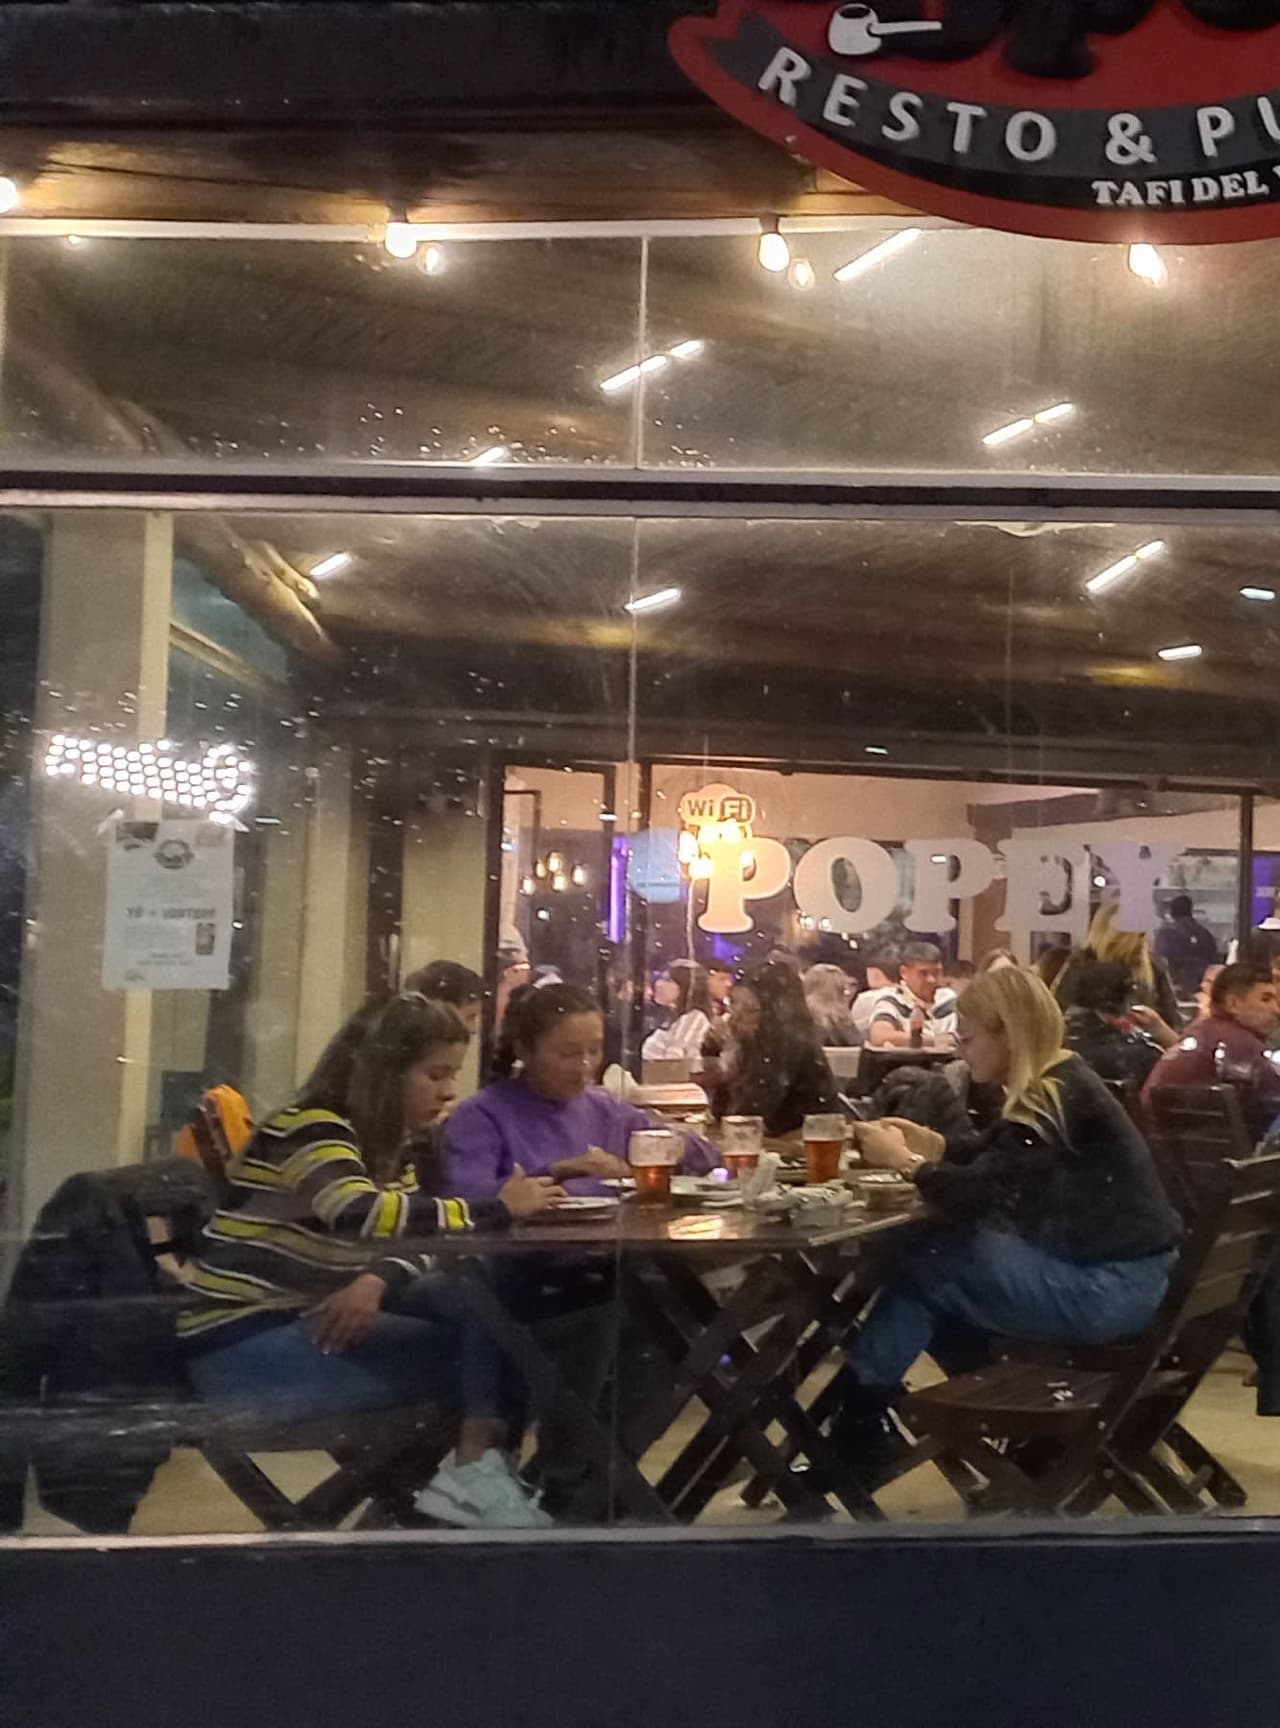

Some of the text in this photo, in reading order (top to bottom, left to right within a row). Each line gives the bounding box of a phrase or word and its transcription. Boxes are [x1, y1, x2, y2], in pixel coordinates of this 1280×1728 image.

[757, 46, 1059, 162] RESTO
[1104, 112, 1158, 166] &
[1090, 178, 1186, 207] TAFI
[1191, 169, 1270, 203] DEL
